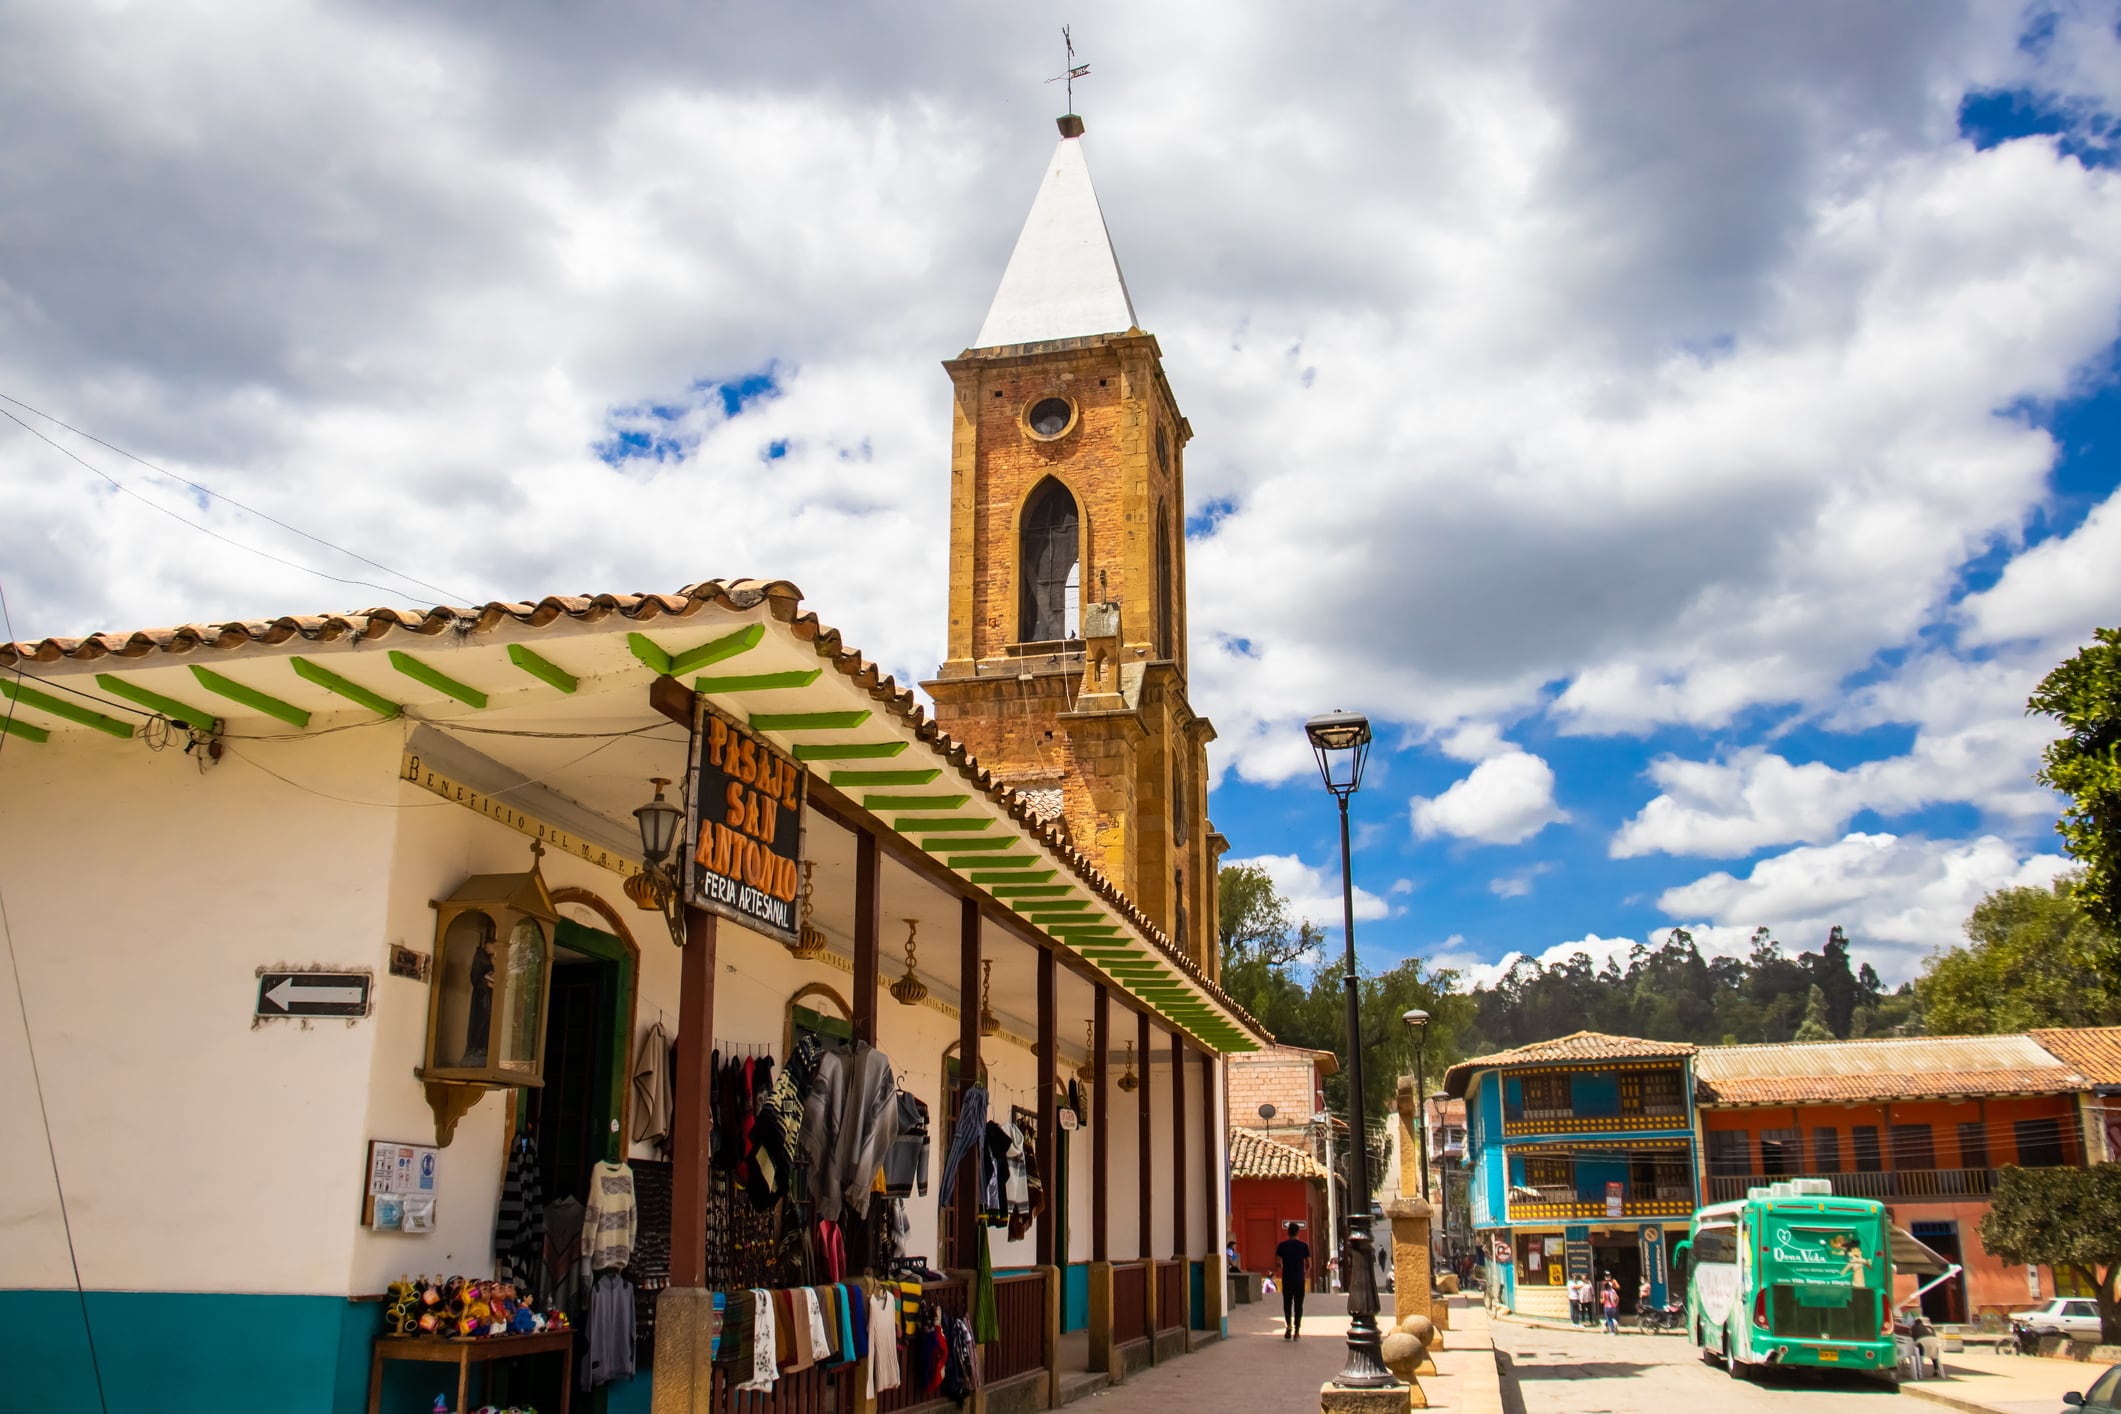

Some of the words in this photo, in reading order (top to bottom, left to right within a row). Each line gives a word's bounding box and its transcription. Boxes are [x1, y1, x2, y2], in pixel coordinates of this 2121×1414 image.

[708, 715, 798, 812] PASAJE
[538, 824, 568, 848] DEL
[726, 781, 778, 844] SAN
[695, 818, 798, 903] ANTONIO
[704, 871, 736, 905] FERIA
[738, 885, 790, 929] ARTESANAL
